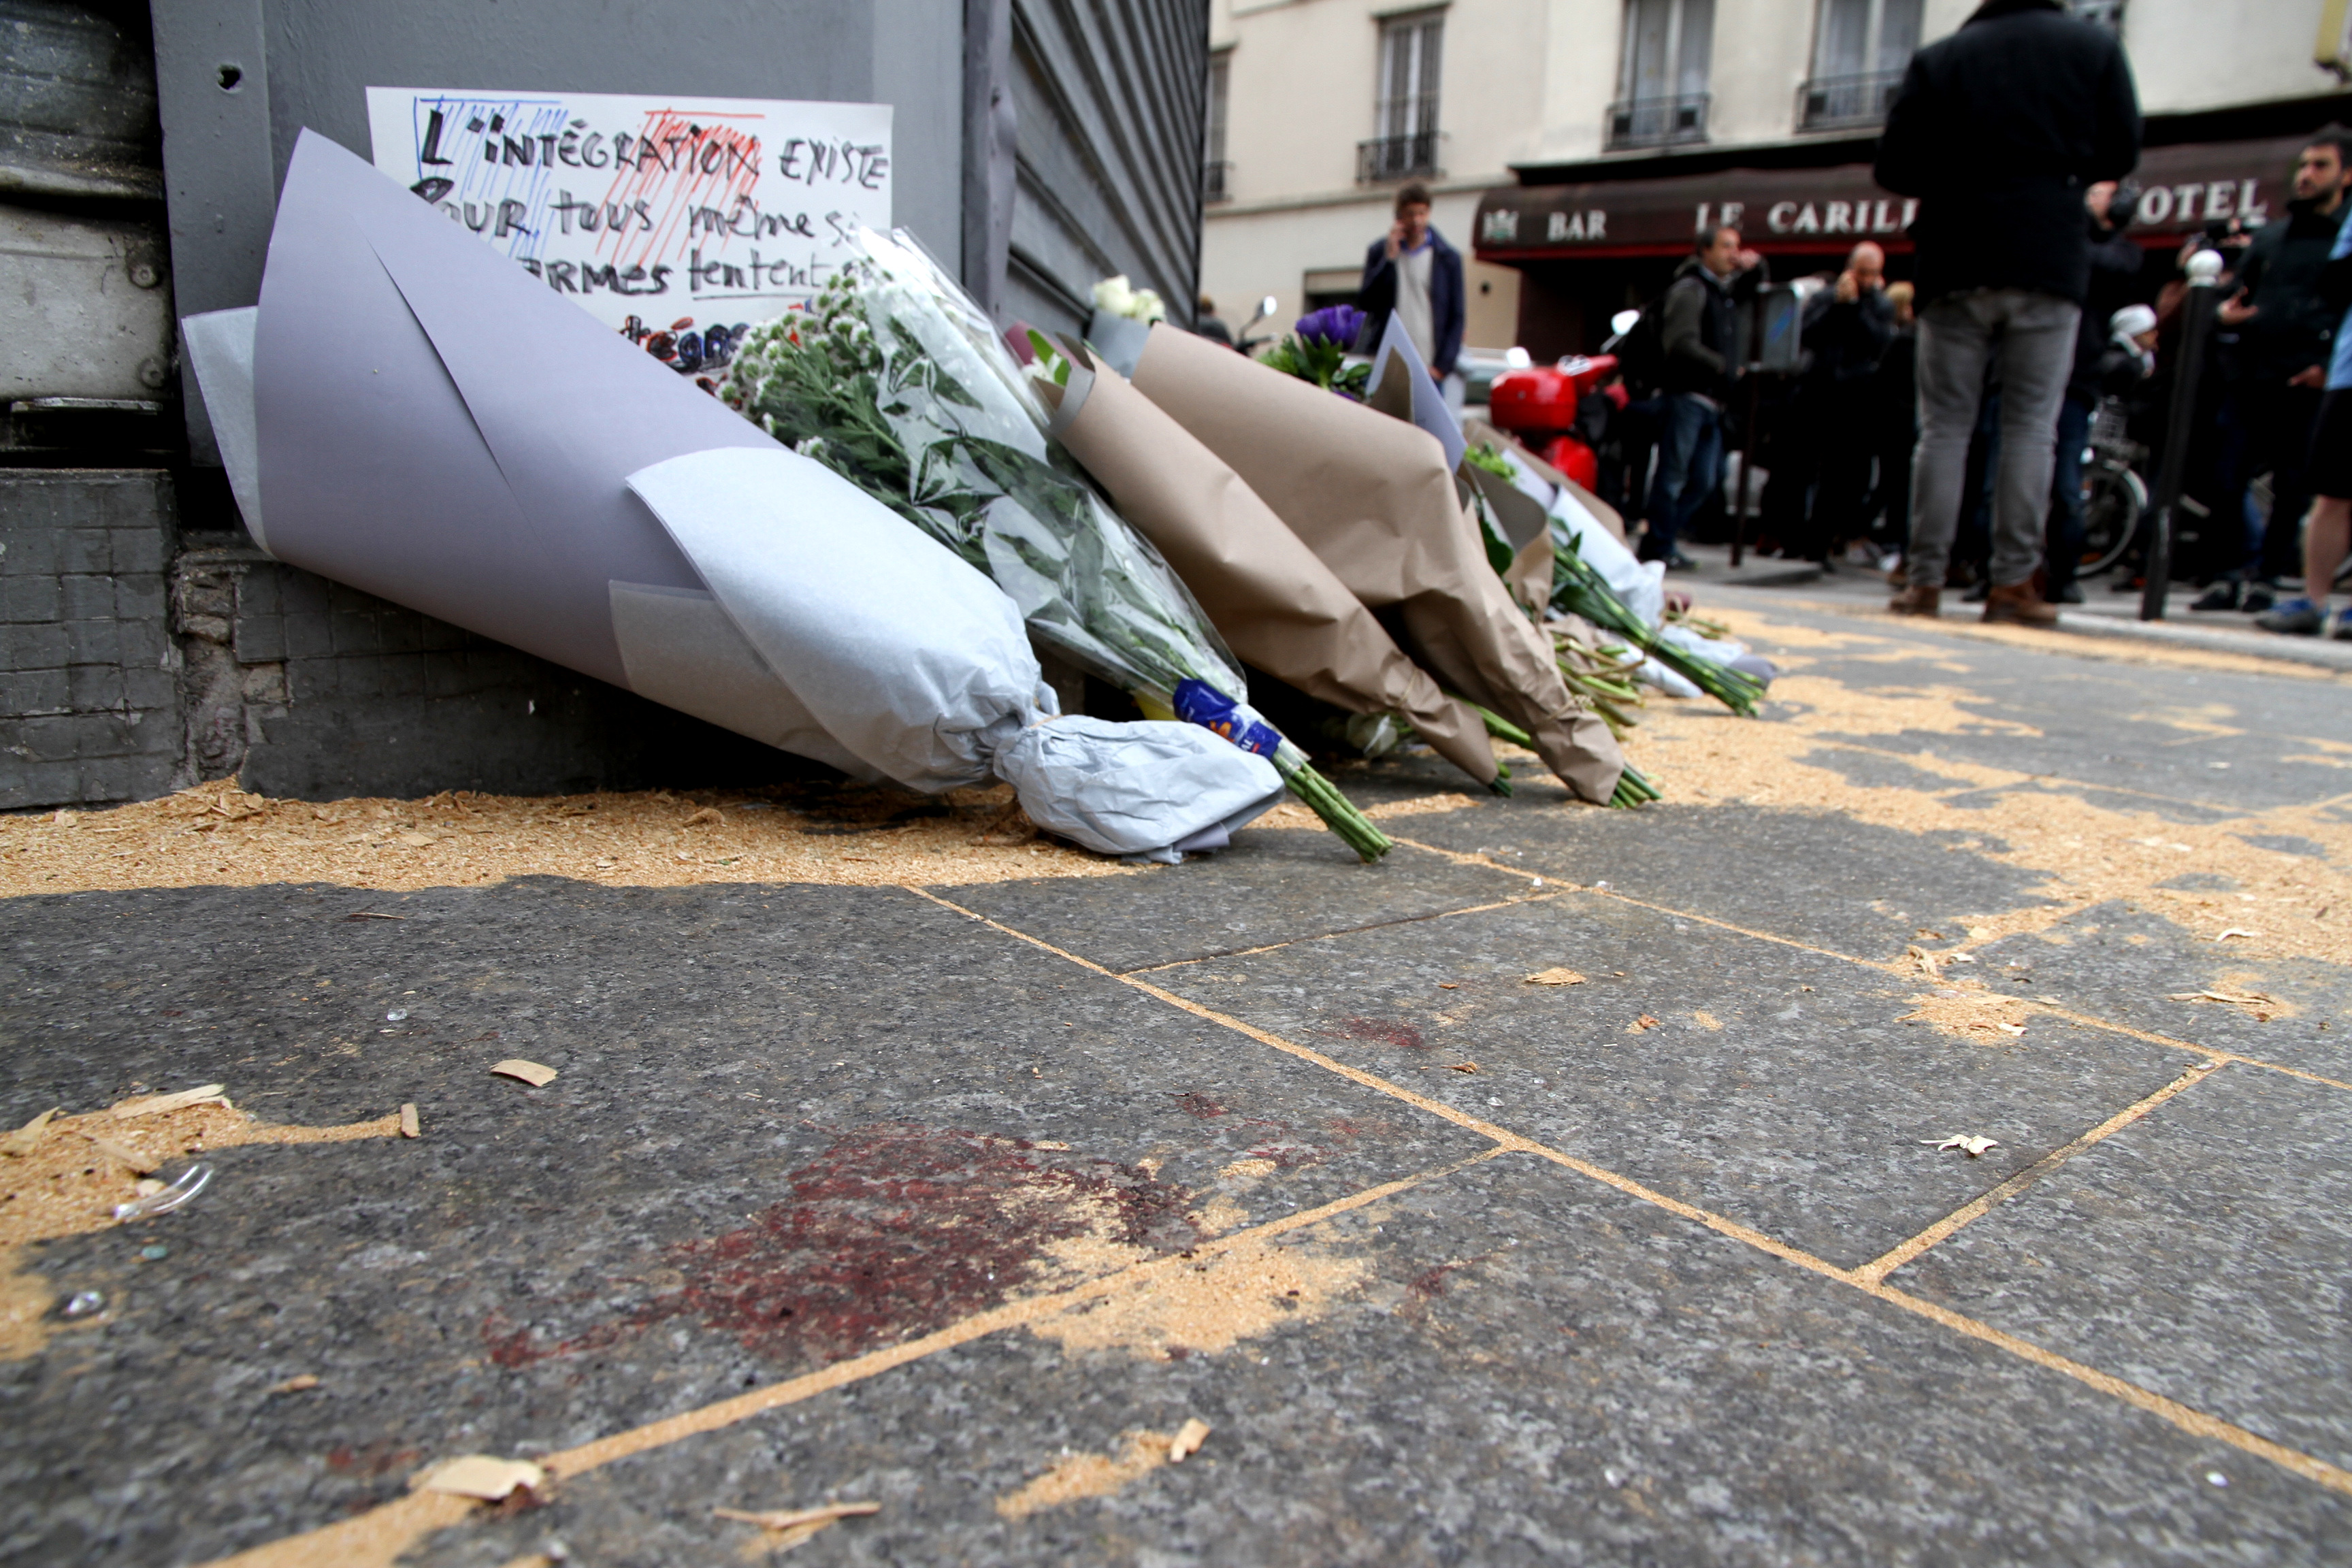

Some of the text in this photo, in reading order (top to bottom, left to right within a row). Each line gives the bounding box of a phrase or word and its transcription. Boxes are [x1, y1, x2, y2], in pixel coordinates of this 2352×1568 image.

[689, 193, 815, 240] même
[1547, 210, 1607, 241] BAR
[1695, 201, 1745, 235] LE
[2137, 178, 2269, 225] OTEL
[687, 248, 832, 291] tentent
